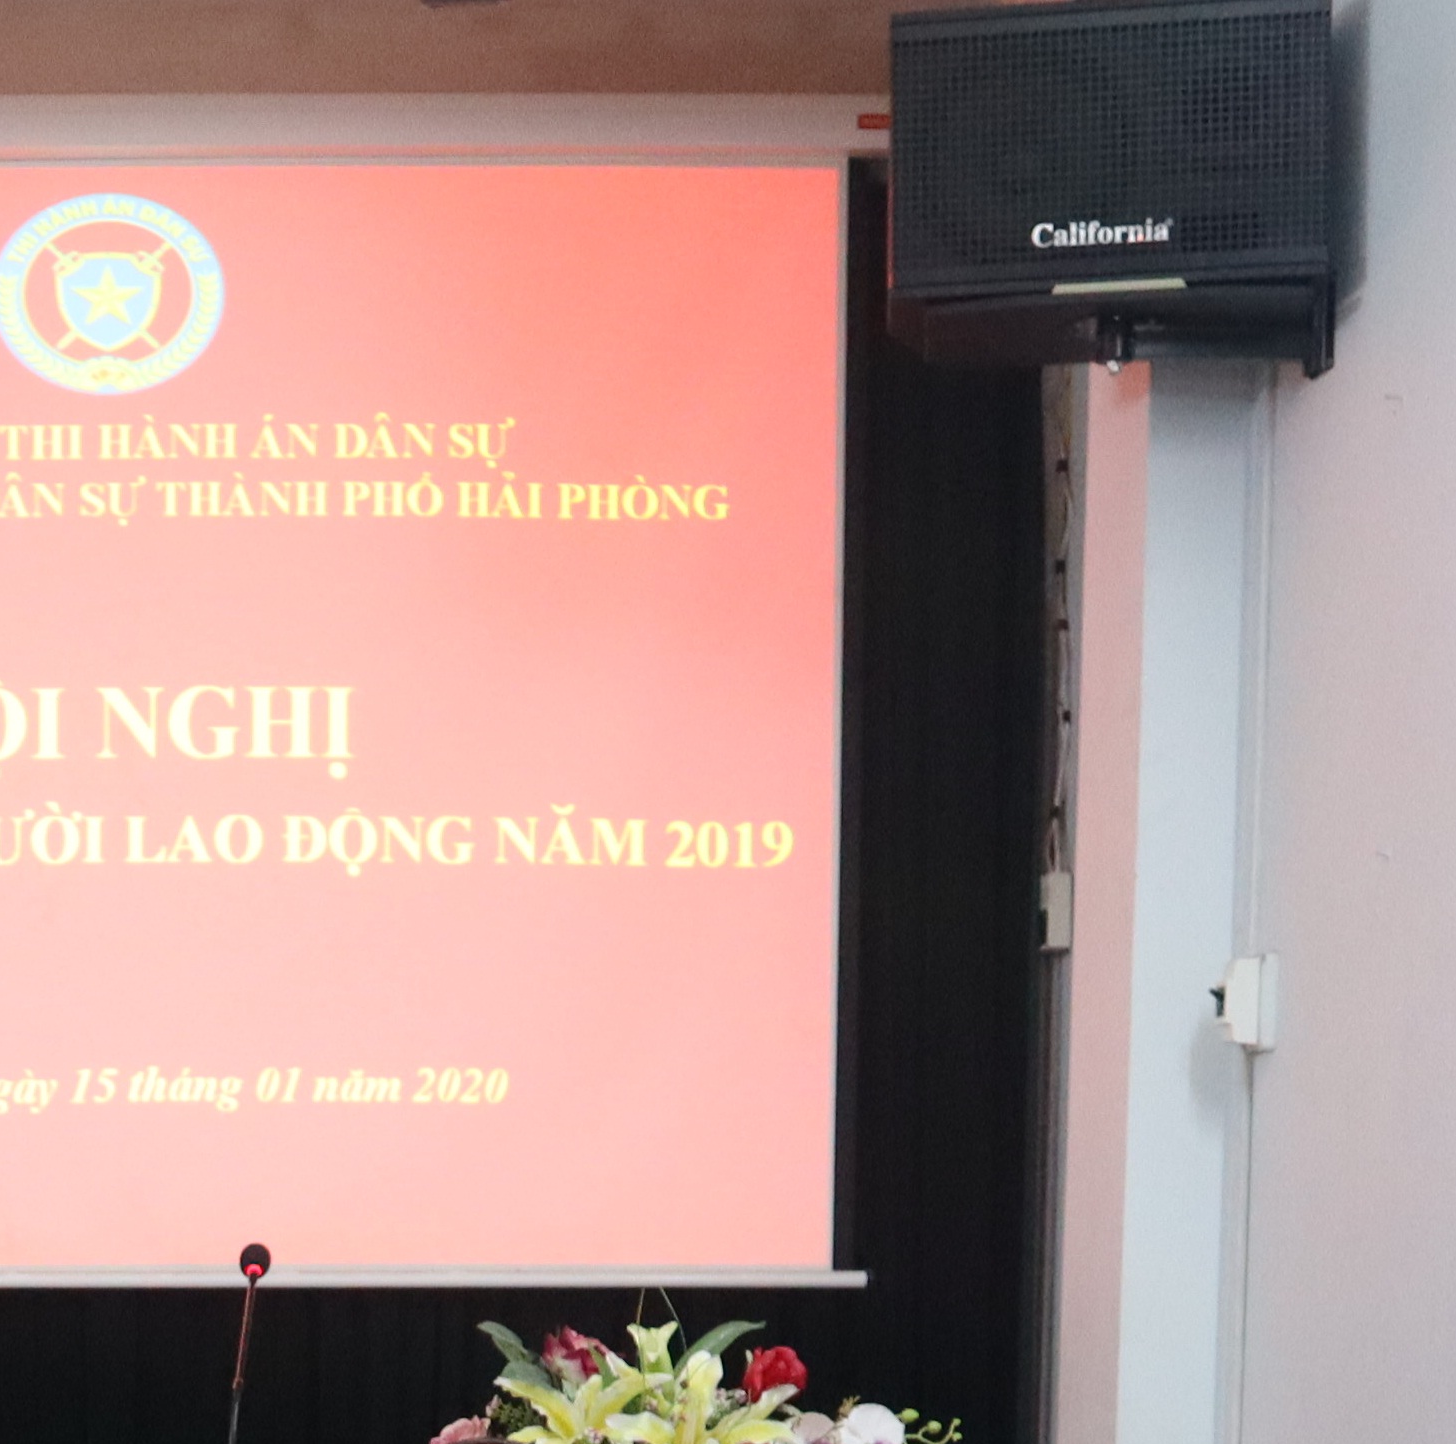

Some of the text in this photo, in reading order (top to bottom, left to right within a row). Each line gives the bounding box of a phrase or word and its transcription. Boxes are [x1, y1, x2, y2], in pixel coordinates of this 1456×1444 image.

[1031, 218, 1172, 249] California
[99, 414, 238, 460] HÀNH
[250, 413, 319, 459] ÁN
[335, 412, 436, 459] DÂN
[448, 417, 517, 468] SỰ
[79, 475, 147, 527] SỰ
[156, 472, 329, 518] THÀNH
[343, 472, 445, 518] PHỐ
[457, 471, 543, 519] HẢI
[557, 471, 731, 523] PHÒNG
[97, 684, 356, 781] NGHỊ
[124, 813, 265, 866] LAO
[282, 807, 476, 879] ĐỘNG
[493, 804, 649, 868] NĂM
[664, 819, 795, 870] 2019
[71, 1067, 120, 1104] 15
[127, 1065, 244, 1114] tháng
[255, 1066, 303, 1104] 01
[312, 1068, 402, 1104] năm
[412, 1066, 510, 1104] 2020
